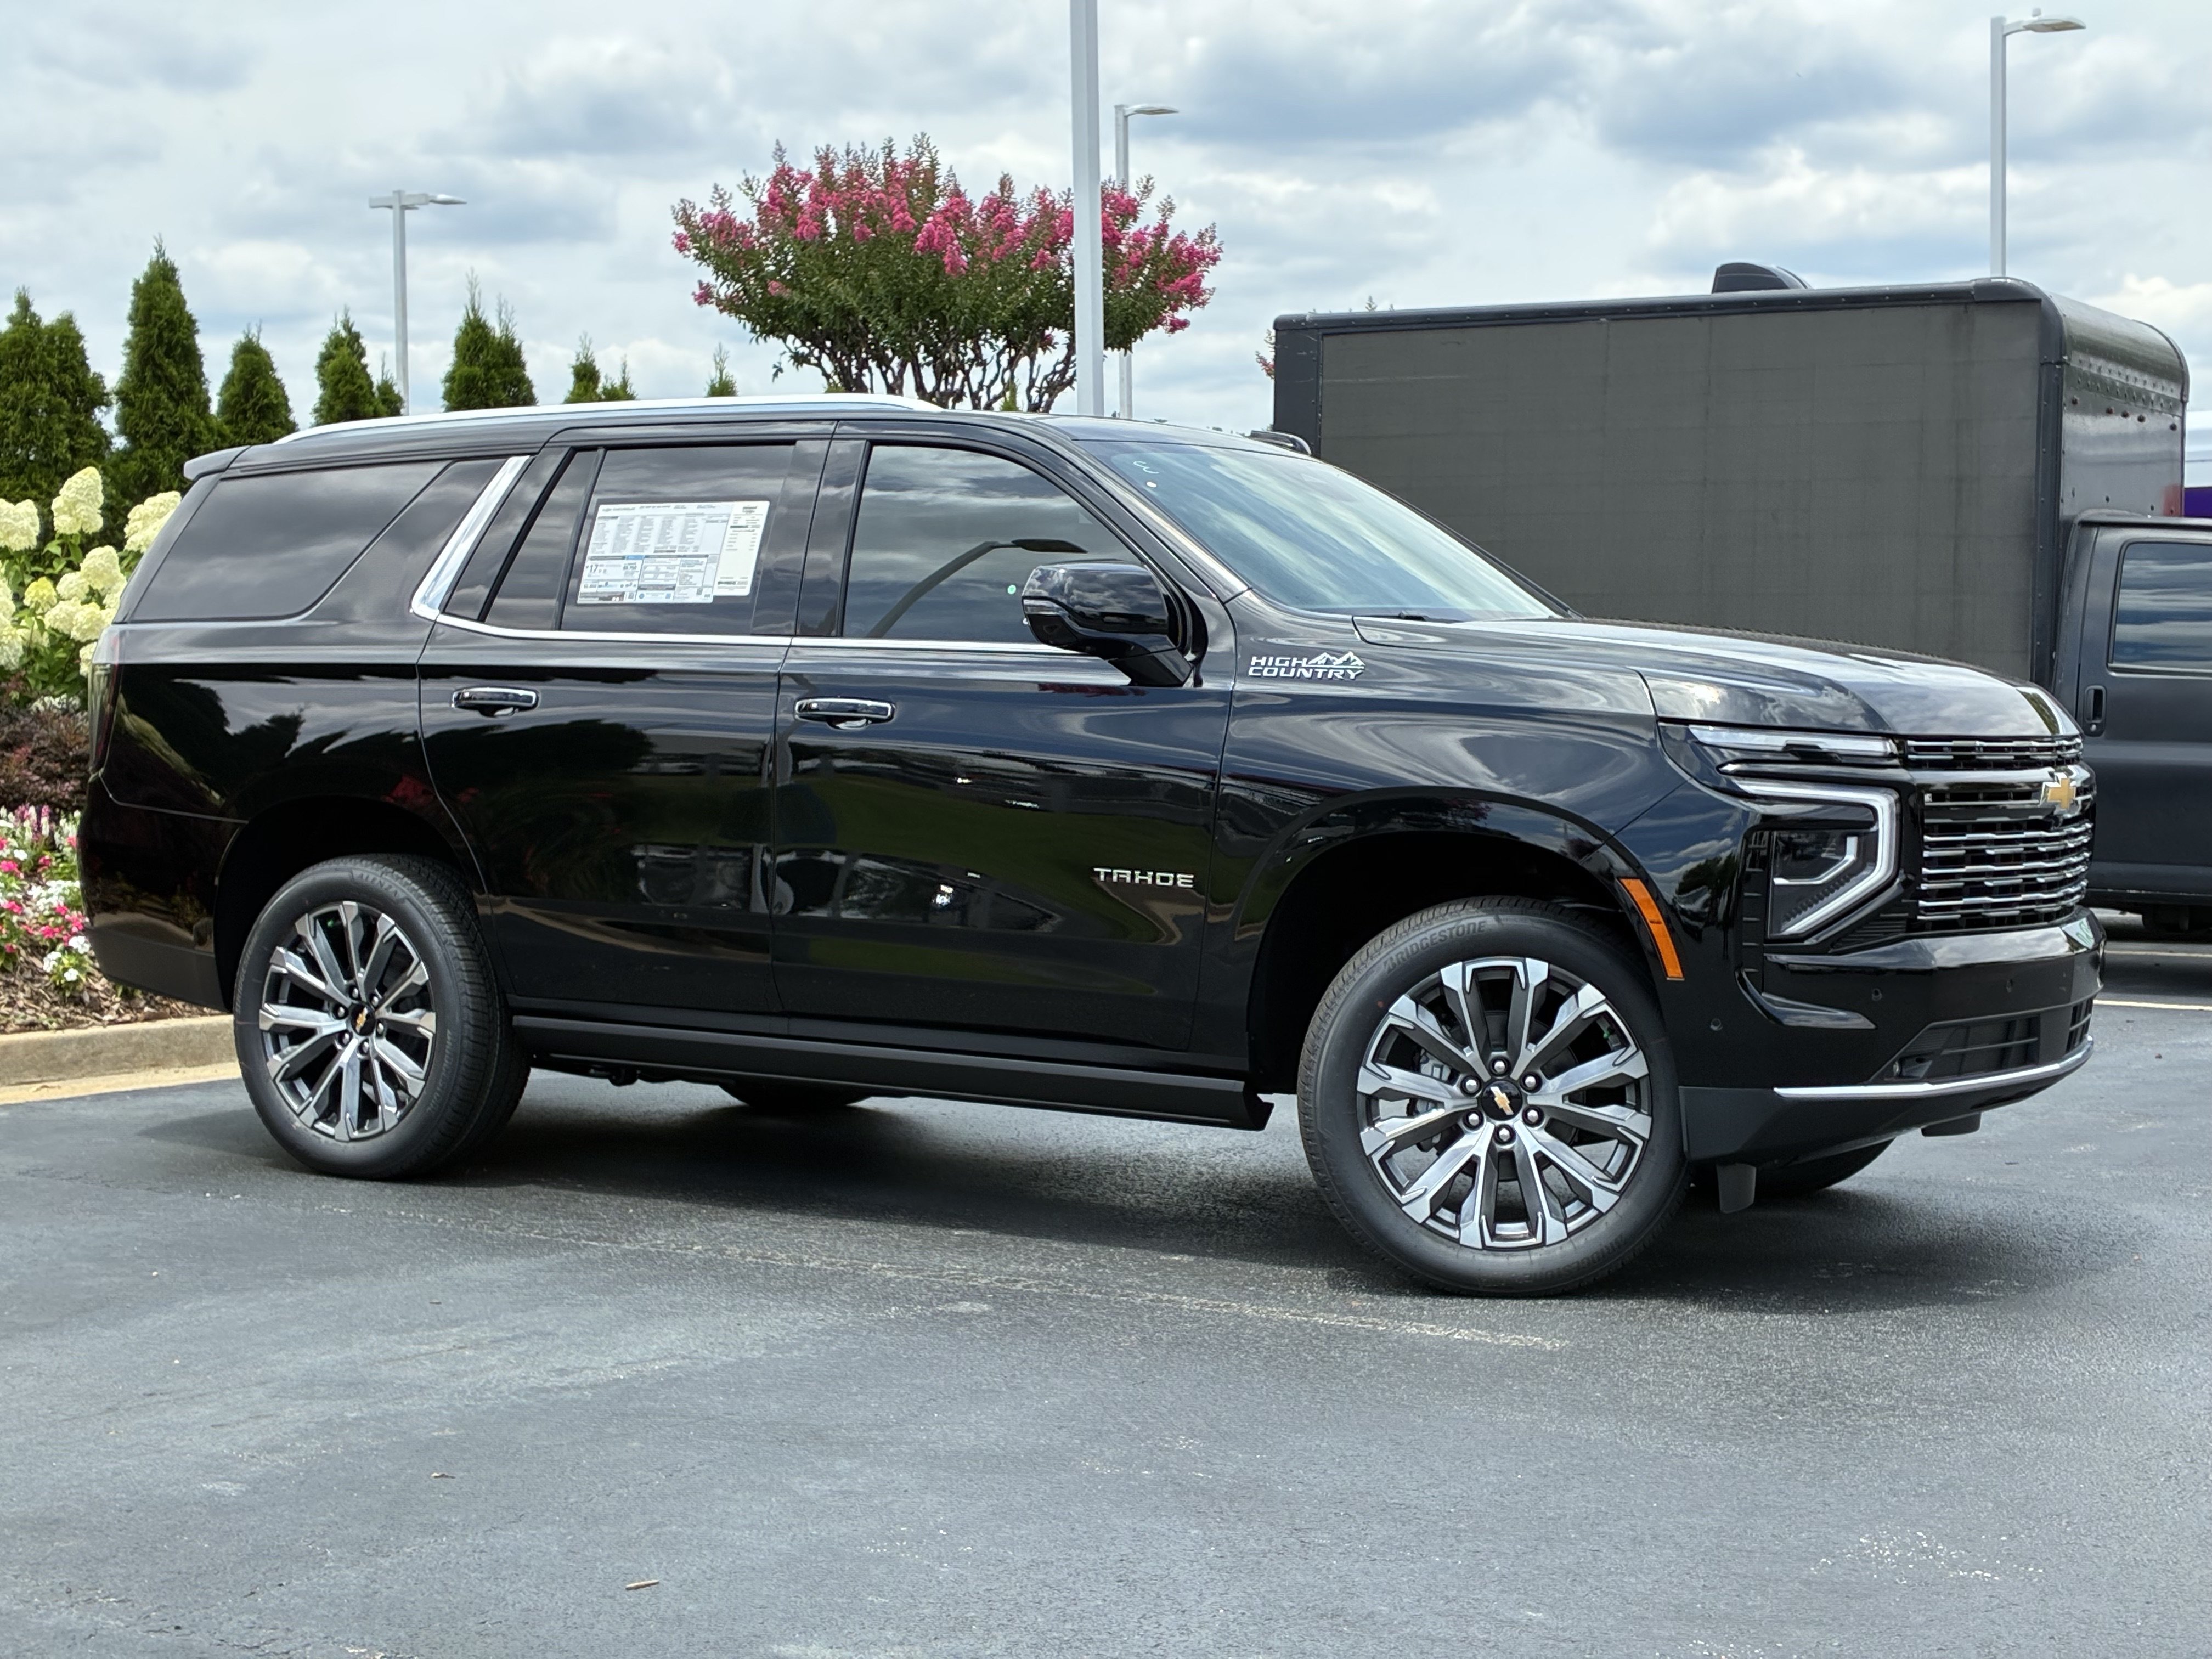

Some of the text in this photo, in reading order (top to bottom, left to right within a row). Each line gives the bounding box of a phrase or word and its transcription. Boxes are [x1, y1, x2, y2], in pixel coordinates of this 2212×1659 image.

[1251, 656, 1308, 667] HIGH
[1248, 667, 1364, 680] COUNTRY
[1093, 867, 1194, 888] TAHOE
[1383, 920, 1487, 974] BRIDGESTONE
